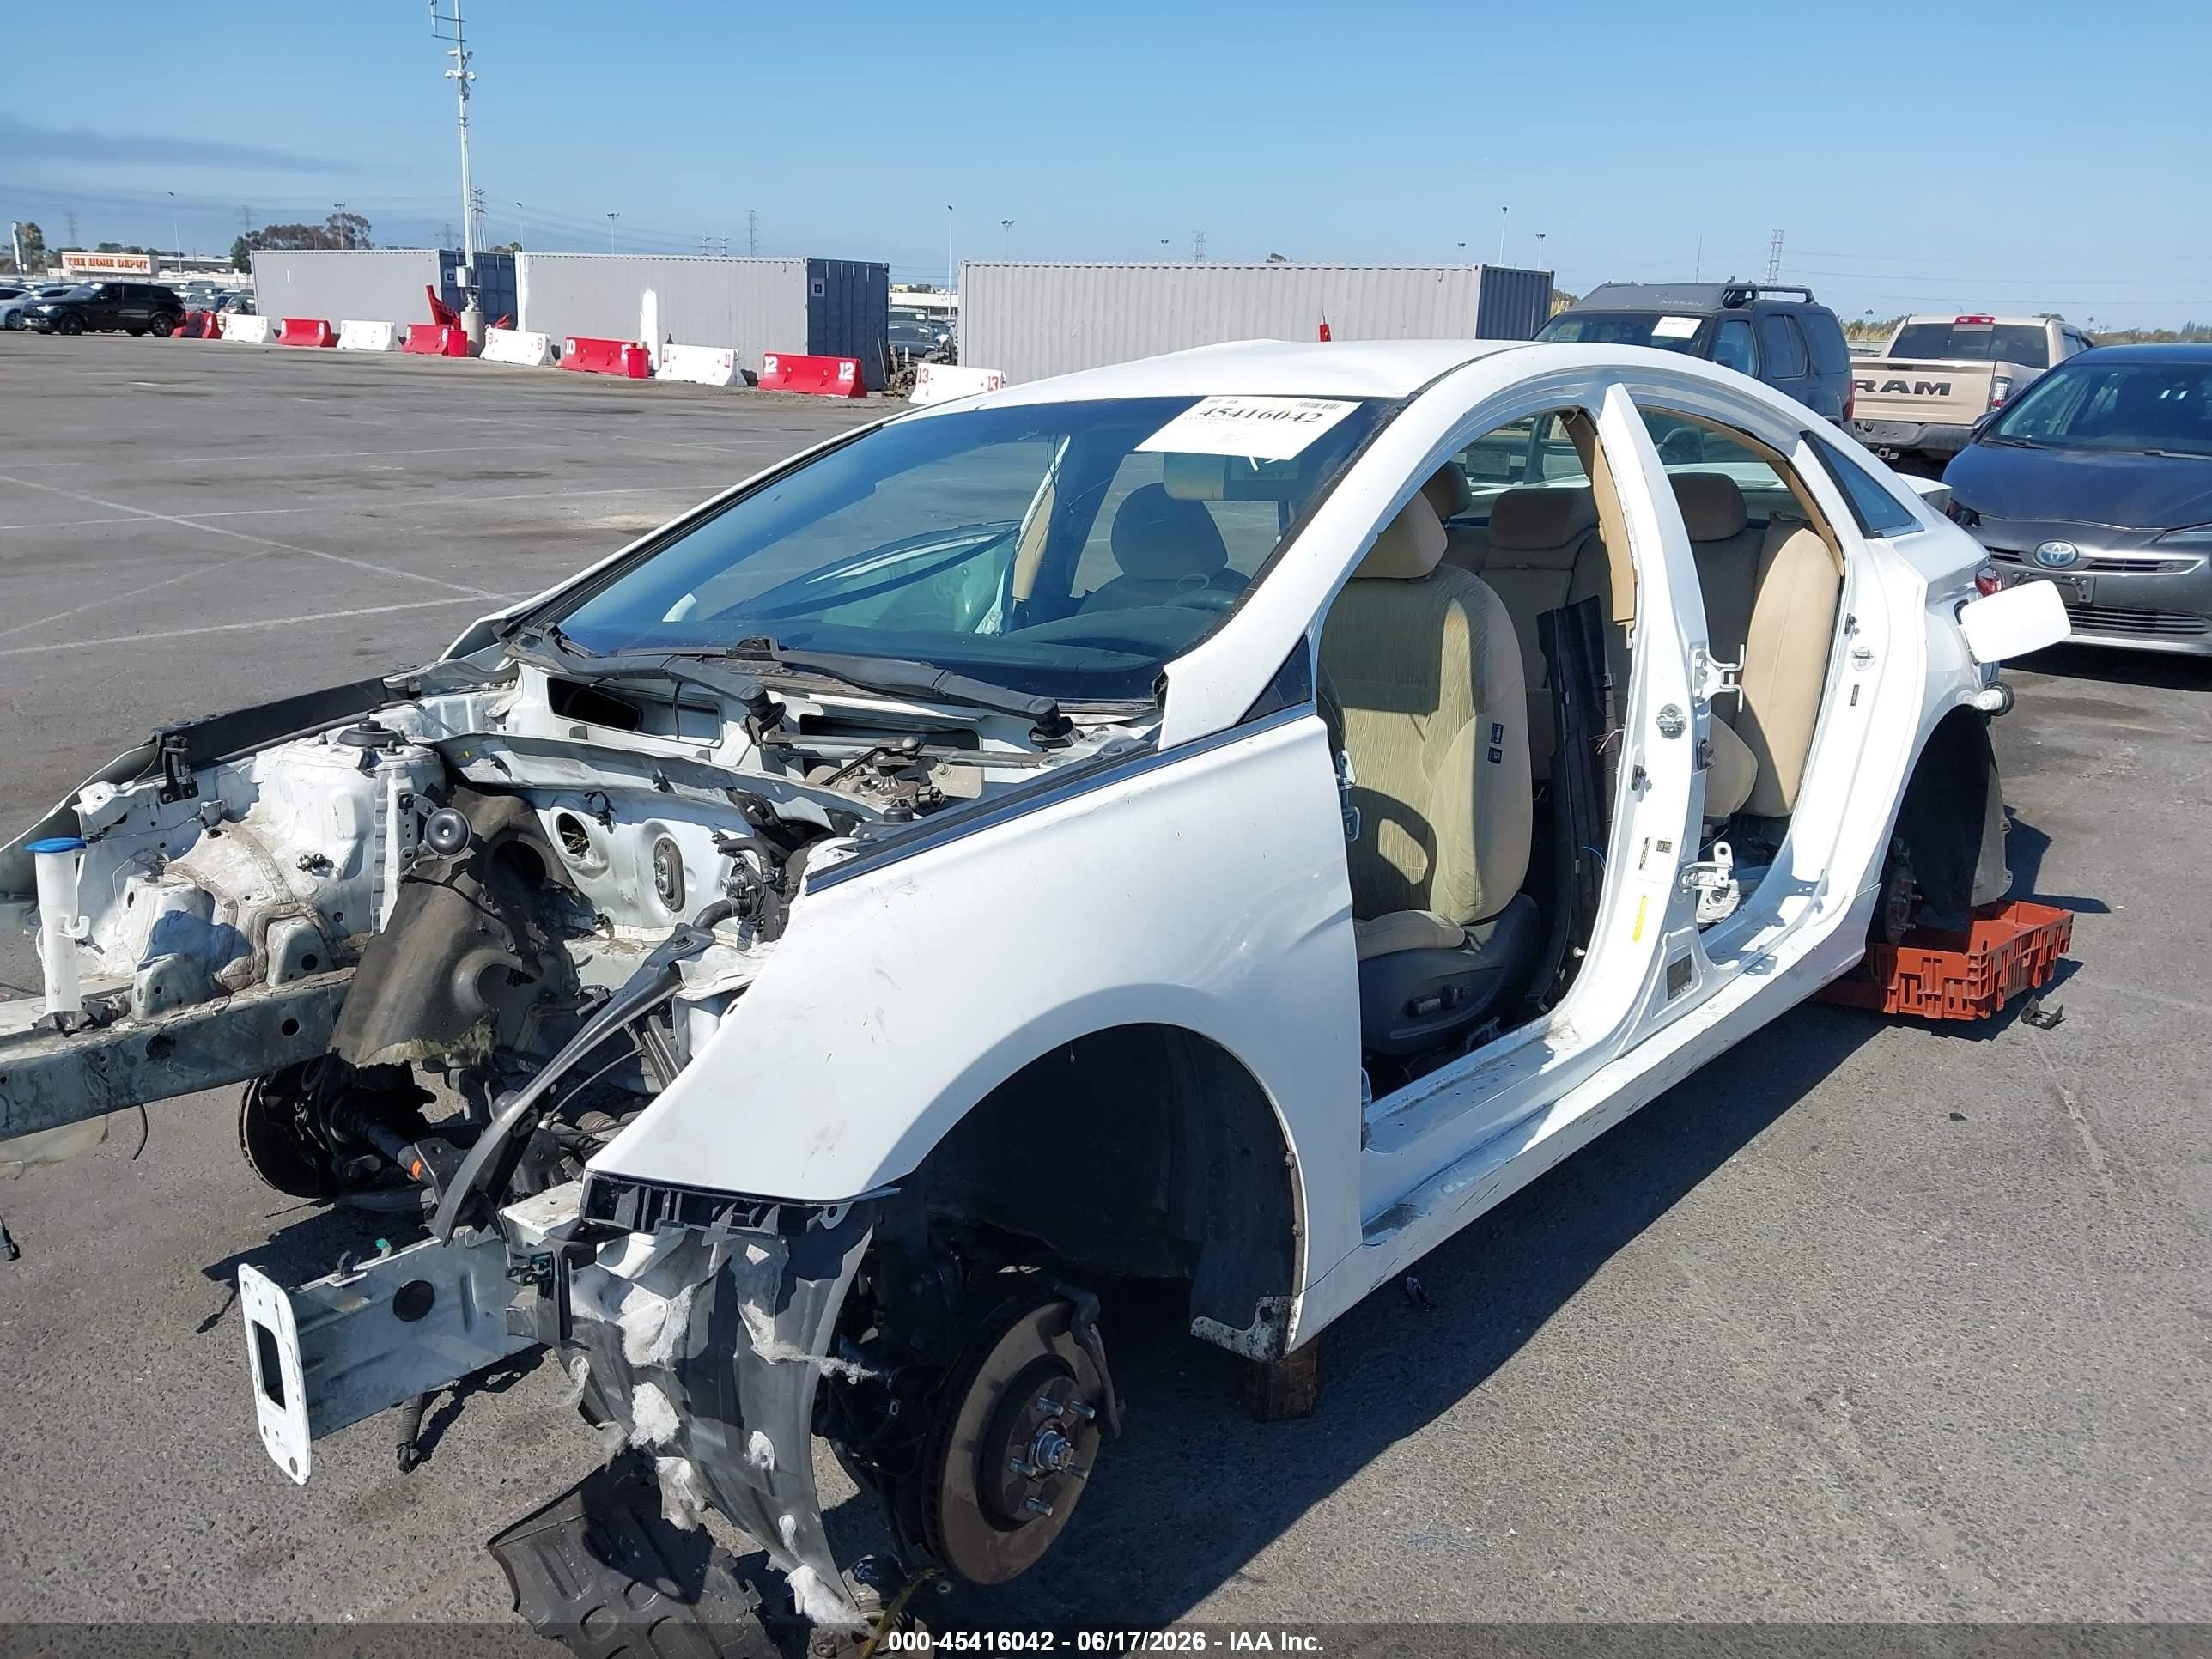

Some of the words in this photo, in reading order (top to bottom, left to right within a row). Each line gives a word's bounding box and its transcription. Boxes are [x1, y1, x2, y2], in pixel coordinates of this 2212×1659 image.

[66, 258, 85, 266] THE
[89, 258, 114, 268] HOME
[118, 260, 148, 269] DEPOT
[566, 339, 576, 354] 10
[663, 349, 670, 362] 11
[725, 354, 731, 368] 11
[763, 356, 777, 373] 12
[838, 362, 854, 380] 12
[918, 368, 929, 384] 13
[988, 375, 999, 391] 13
[1853, 379, 1951, 396] RAM
[1199, 407, 1323, 423] 45416042
